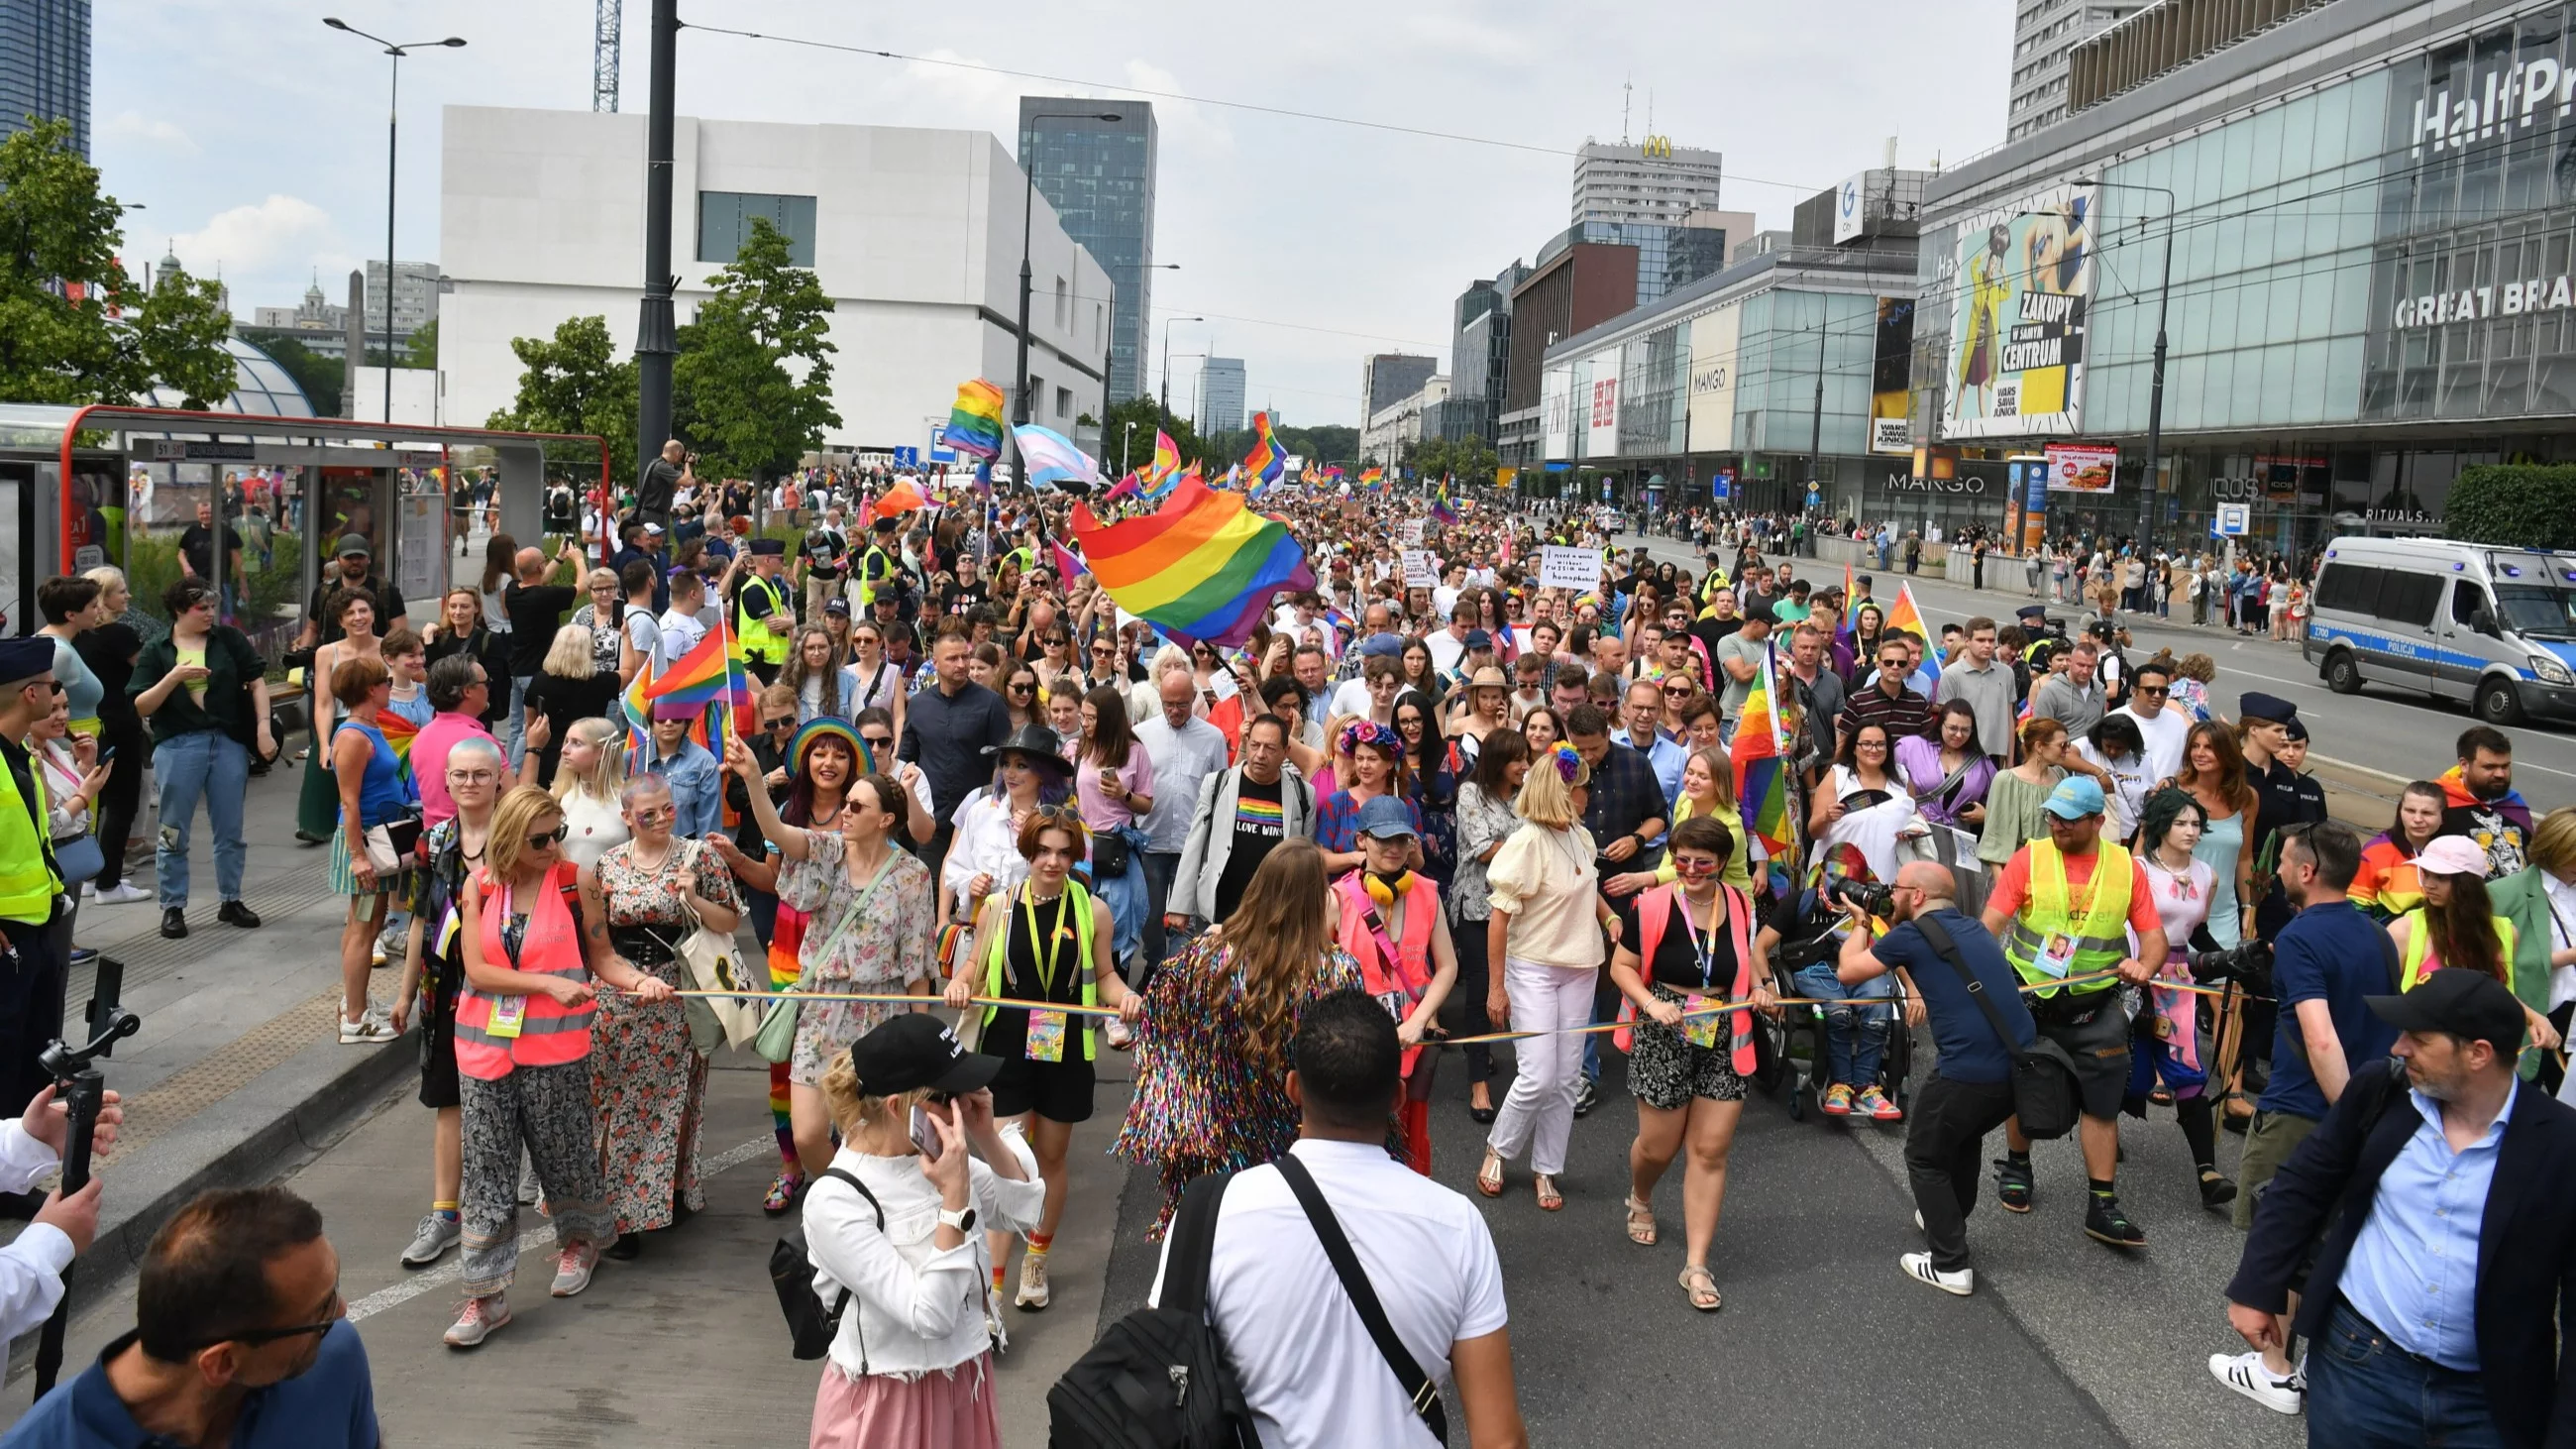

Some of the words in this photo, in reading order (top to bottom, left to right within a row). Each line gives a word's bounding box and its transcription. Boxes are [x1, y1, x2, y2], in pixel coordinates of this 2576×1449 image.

[2021, 292, 2075, 325] ZAKUPY
[2395, 286, 2491, 328] GREAT
[2502, 276, 2576, 315] BRA
[2012, 327, 2019, 340] W
[2020, 325, 2044, 340] SAMYM
[2002, 338, 2062, 371] CENTRUM
[1693, 368, 1726, 392] MANGO
[1997, 387, 2016, 396] WARS
[1997, 397, 2015, 406] SAWA
[1993, 407, 2016, 417] JUNIOR
[2210, 477, 2259, 501] IQOS
[2388, 641, 2415, 655] POLICJA
[1236, 821, 1258, 835] LOVE
[1262, 825, 1284, 836] WINS
